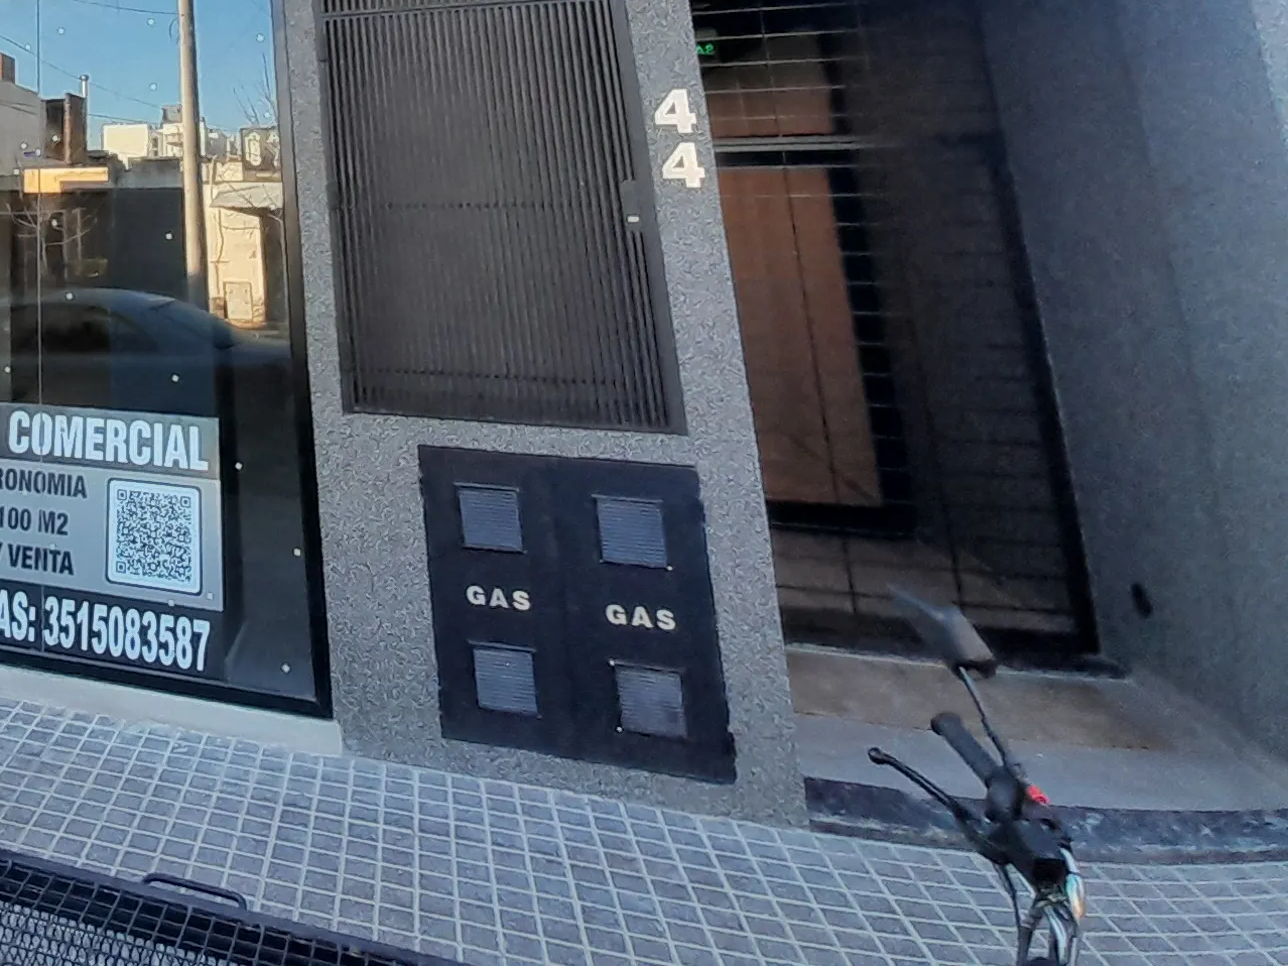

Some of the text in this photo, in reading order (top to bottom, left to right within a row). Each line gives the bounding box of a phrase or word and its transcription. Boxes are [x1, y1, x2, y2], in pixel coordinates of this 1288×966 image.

[9, 410, 209, 471] COMERCIAL
[38, 510, 69, 536] M2
[8, 544, 74, 575] VENTA
[466, 585, 531, 611] GAS
[605, 604, 677, 631] GAS
[43, 596, 211, 671] 3515083587
